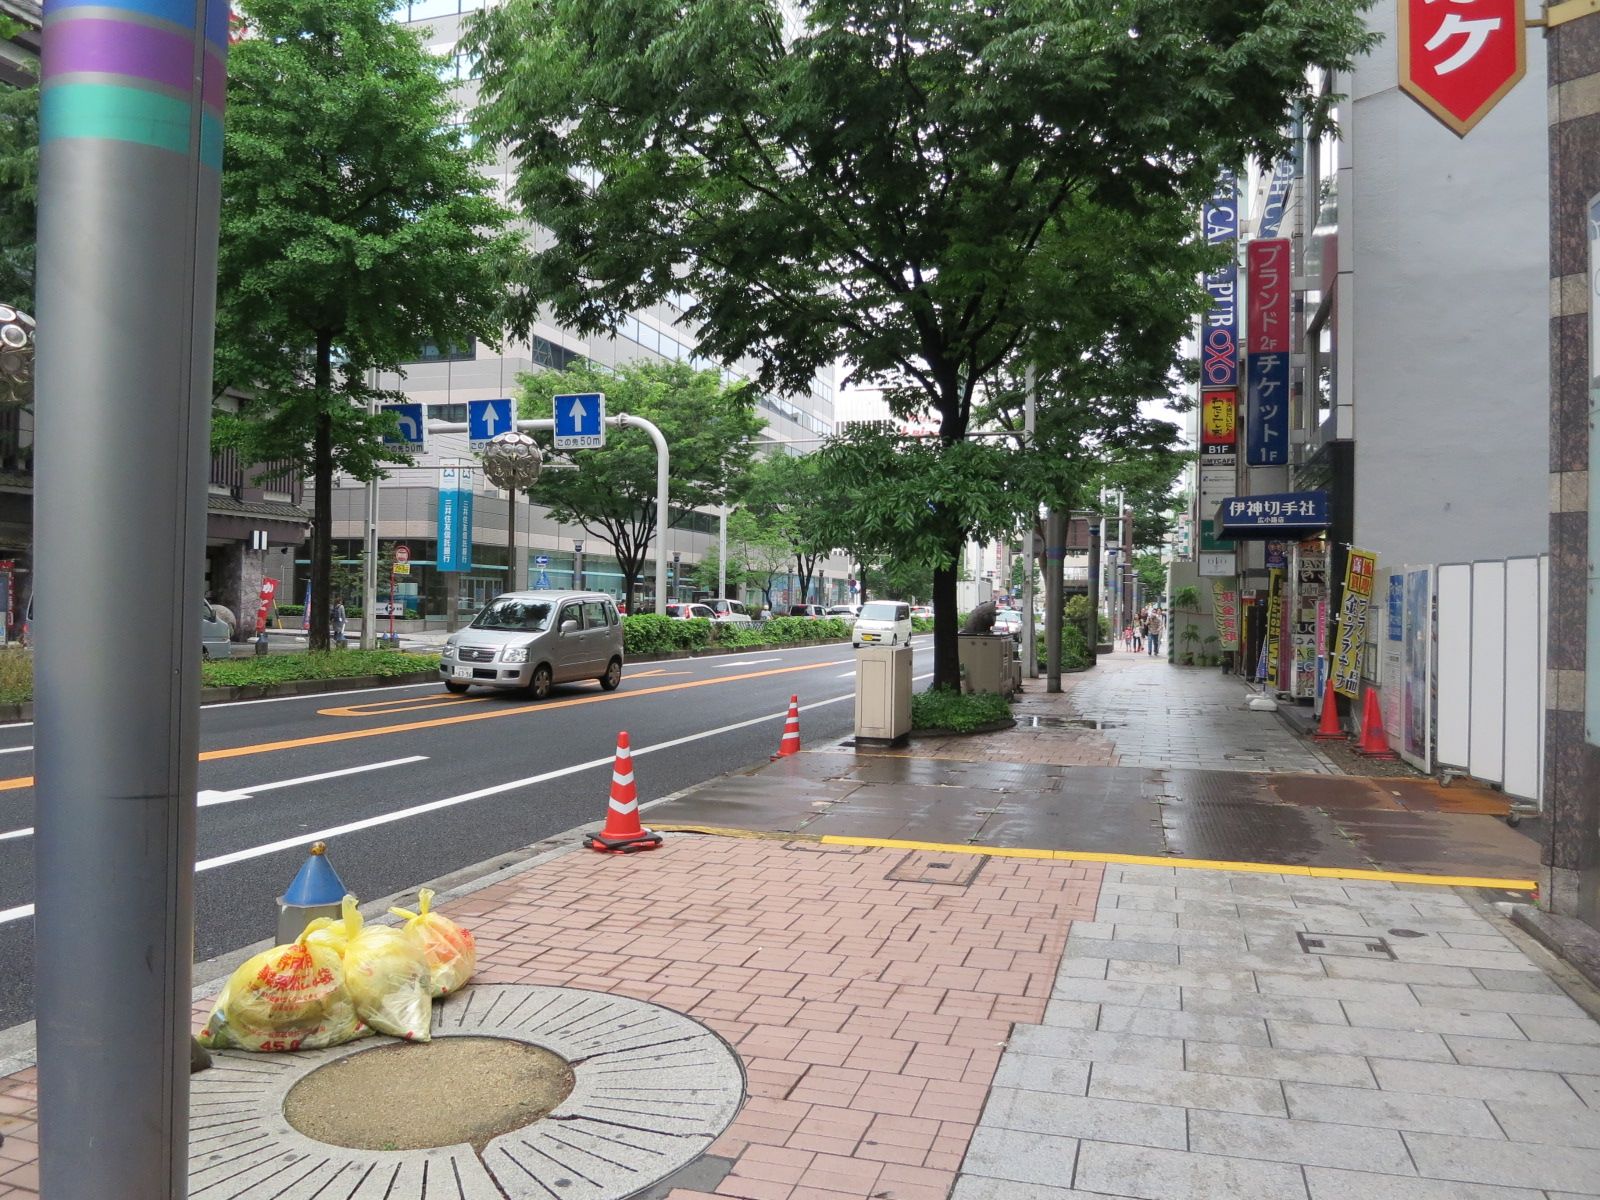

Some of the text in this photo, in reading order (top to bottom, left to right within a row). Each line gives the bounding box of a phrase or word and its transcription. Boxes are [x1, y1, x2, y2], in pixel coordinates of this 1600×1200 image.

[1424, 0, 1501, 76] ケ
[1256, 355, 1281, 462] チケット 1F
[1208, 445, 1229, 454] B1F
[1228, 500, 1317, 517] 伊神切手社
